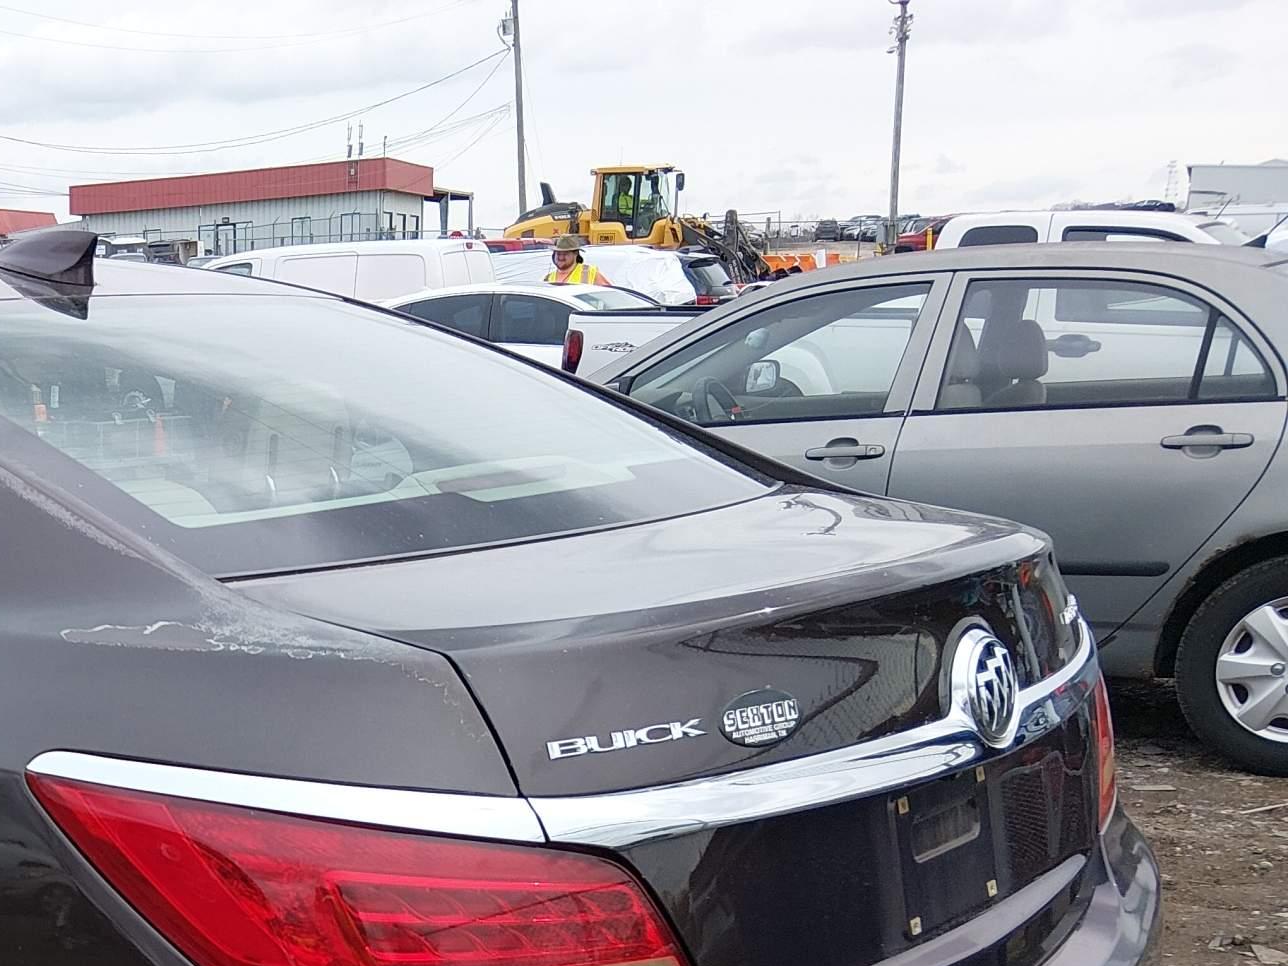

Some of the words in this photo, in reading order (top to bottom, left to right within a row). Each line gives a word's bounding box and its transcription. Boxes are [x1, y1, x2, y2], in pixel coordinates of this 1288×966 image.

[723, 699, 799, 732] SEXTON
[732, 725, 774, 739] AUTOMOTIVE
[546, 718, 708, 760] BUICK
